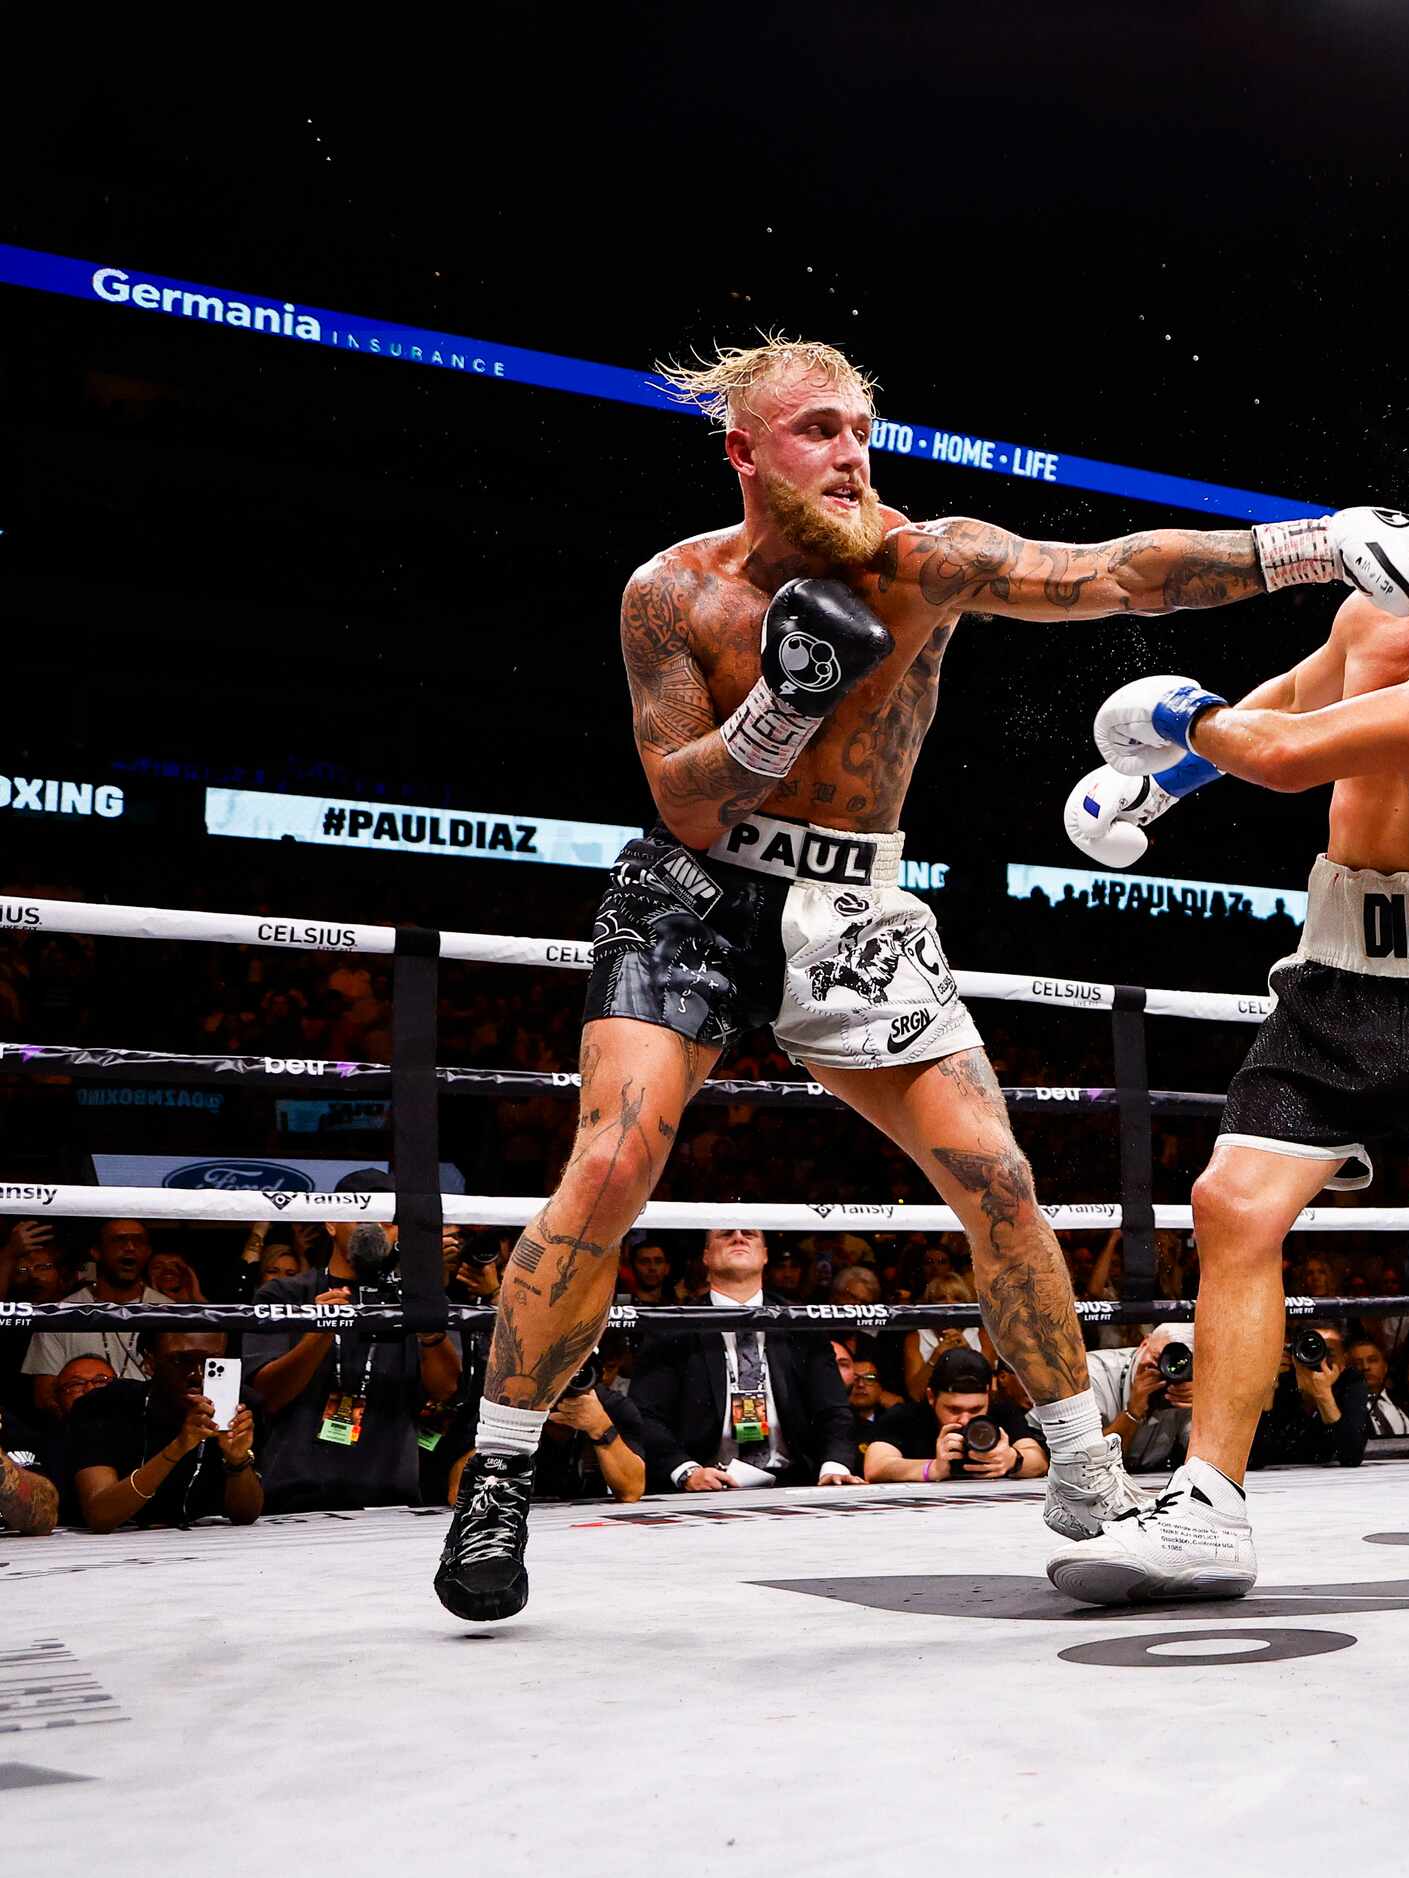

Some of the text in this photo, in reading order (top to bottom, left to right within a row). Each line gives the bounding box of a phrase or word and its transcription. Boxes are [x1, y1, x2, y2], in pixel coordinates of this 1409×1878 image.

[92, 267, 506, 377] Germania INSURANCE
[870, 420, 1059, 482] UTO HOME LIFE
[322, 807, 538, 854] #PAULDIAZ
[727, 822, 866, 879] PAUL
[258, 923, 358, 948] CELSIUS
[1032, 980, 1101, 1001] CELSIUS
[891, 1007, 930, 1039] SRGN
[264, 1057, 329, 1076] betr
[1035, 1087, 1081, 1101] betr
[303, 1192, 373, 1210] fansly
[1285, 1296, 1316, 1307] IUS
[254, 1303, 357, 1319] CELSIUS
[608, 1305, 638, 1319] US
[806, 1304, 888, 1318] CELSIUS
[15, 1319, 32, 1327] FIT
[317, 1320, 354, 1328] LIVE FIT
[607, 1320, 636, 1328] IVE FIT
[875, 1318, 887, 1326] FIT
